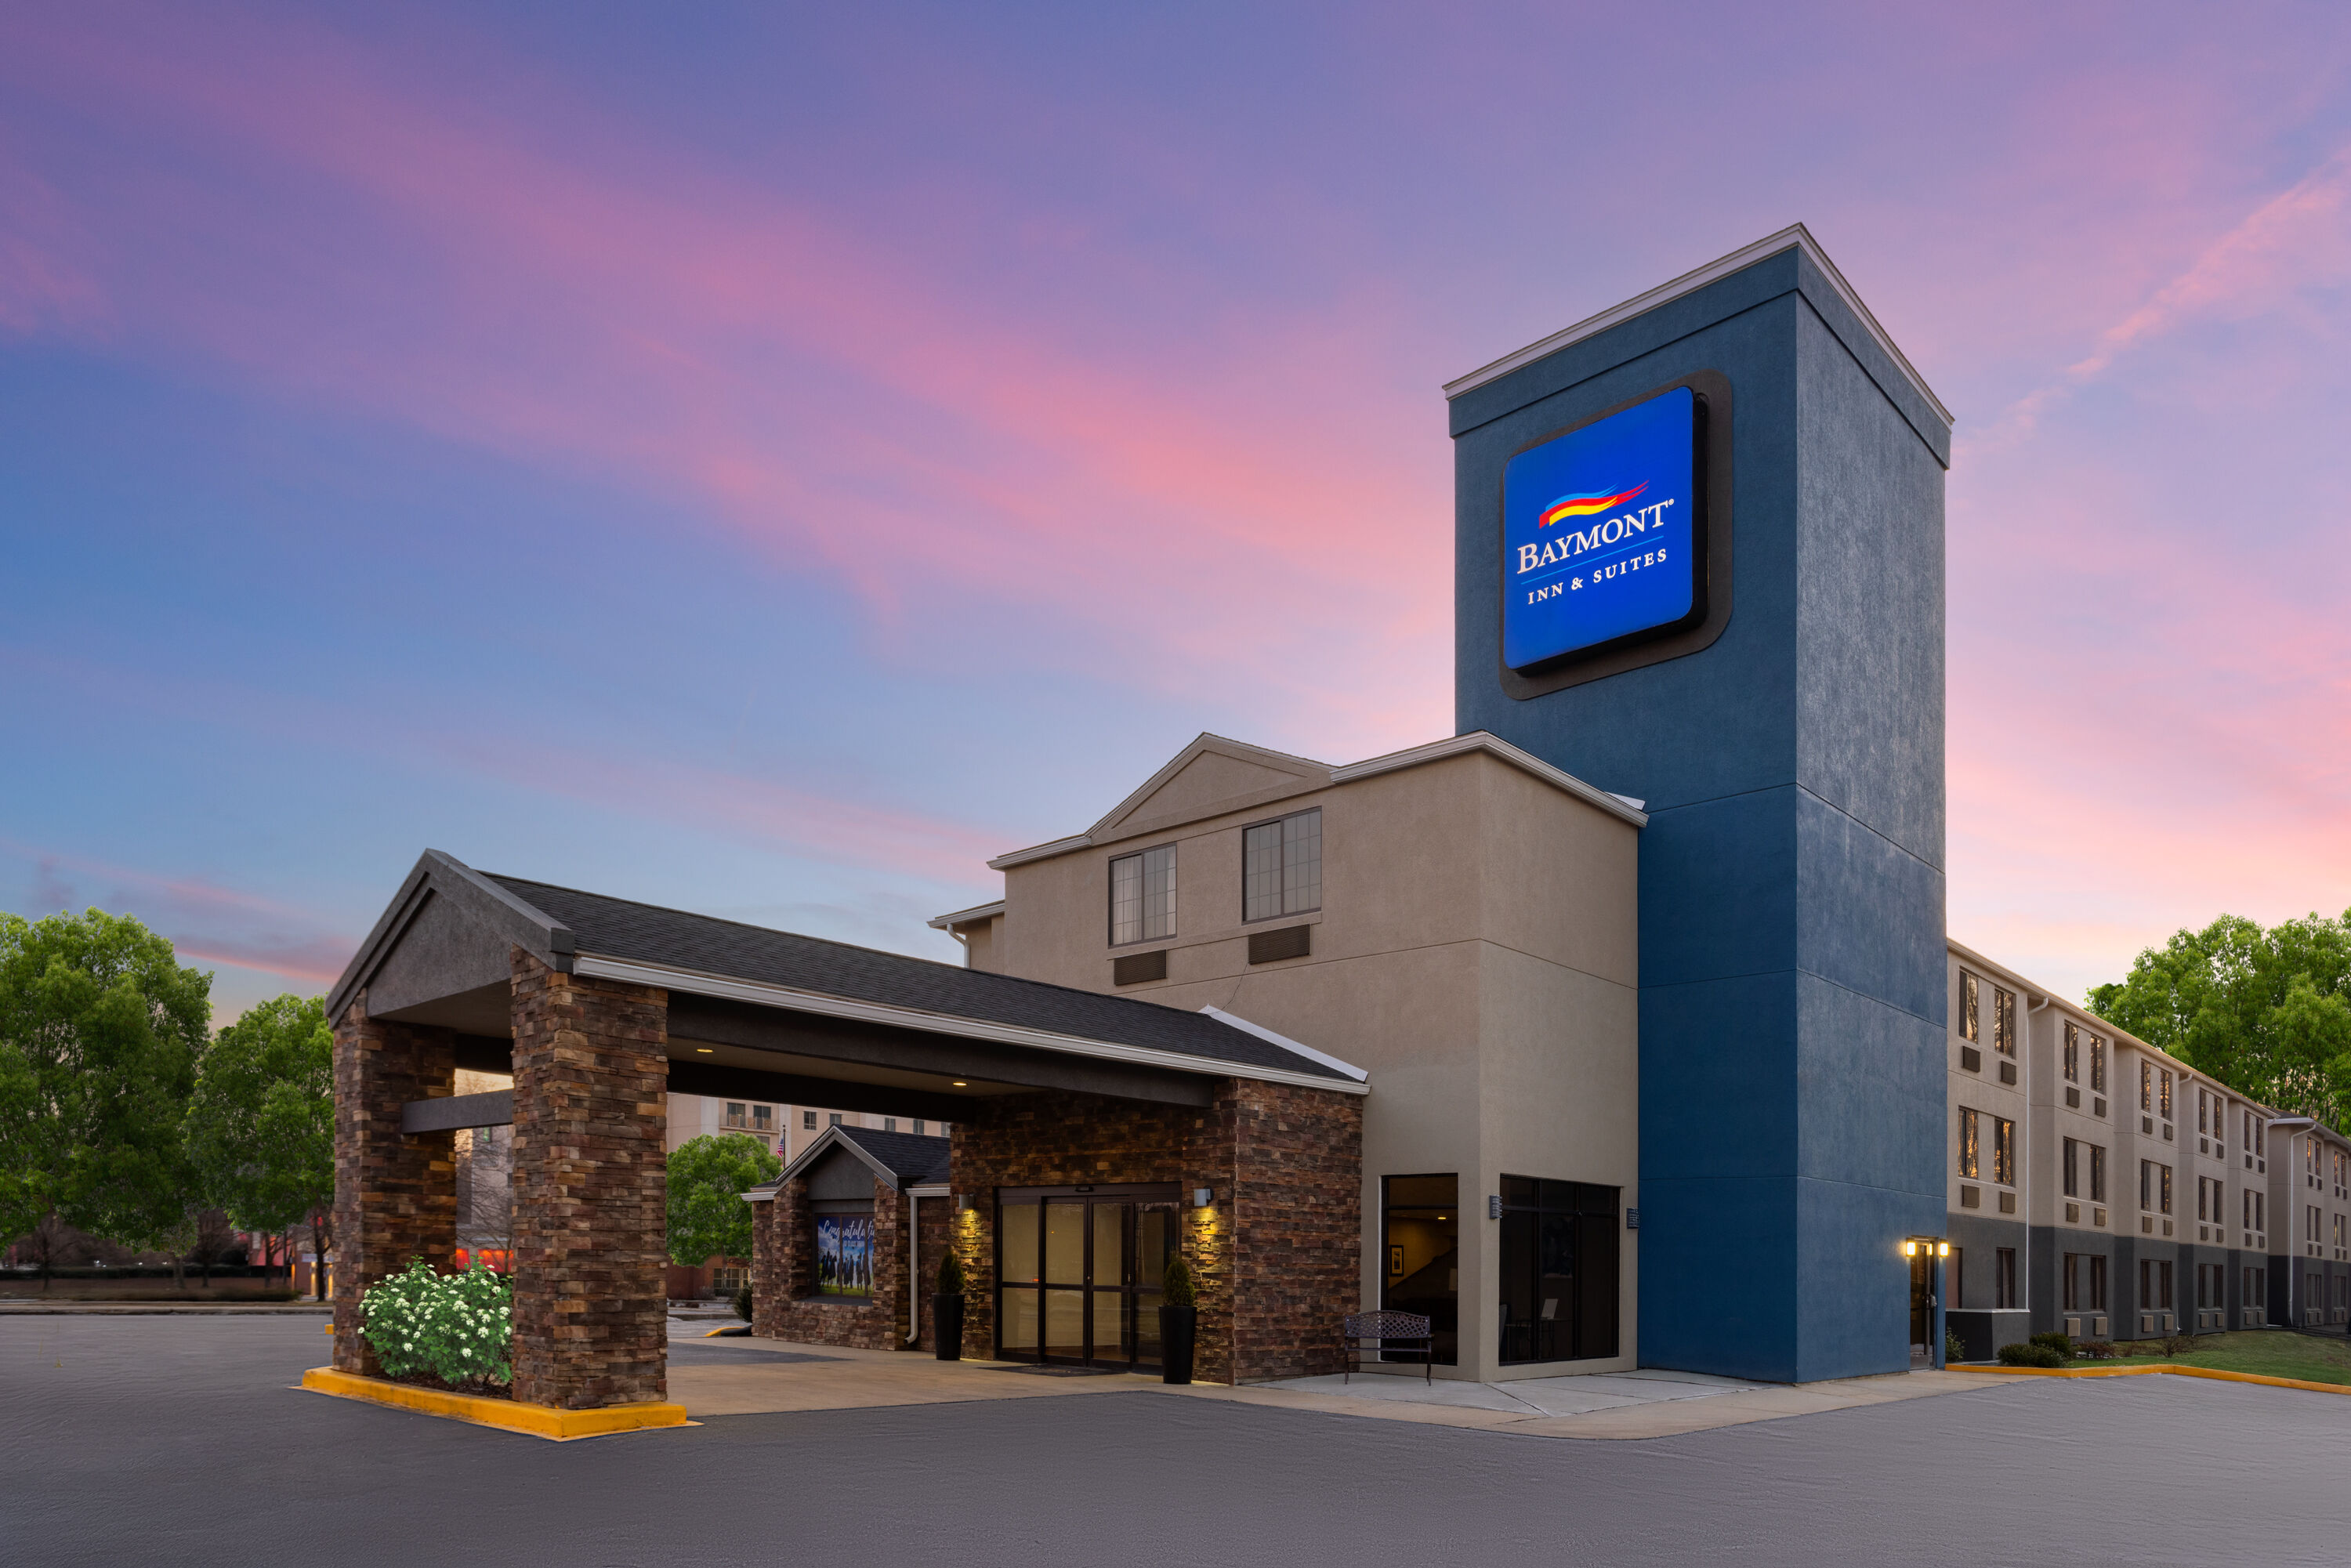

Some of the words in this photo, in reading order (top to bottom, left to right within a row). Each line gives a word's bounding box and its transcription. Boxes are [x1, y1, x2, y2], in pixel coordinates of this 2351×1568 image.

[1516, 499, 1669, 574] BAYMONT
[1528, 582, 1564, 605] INN
[1570, 577, 1584, 591] &
[1593, 548, 1667, 584] SUITES
